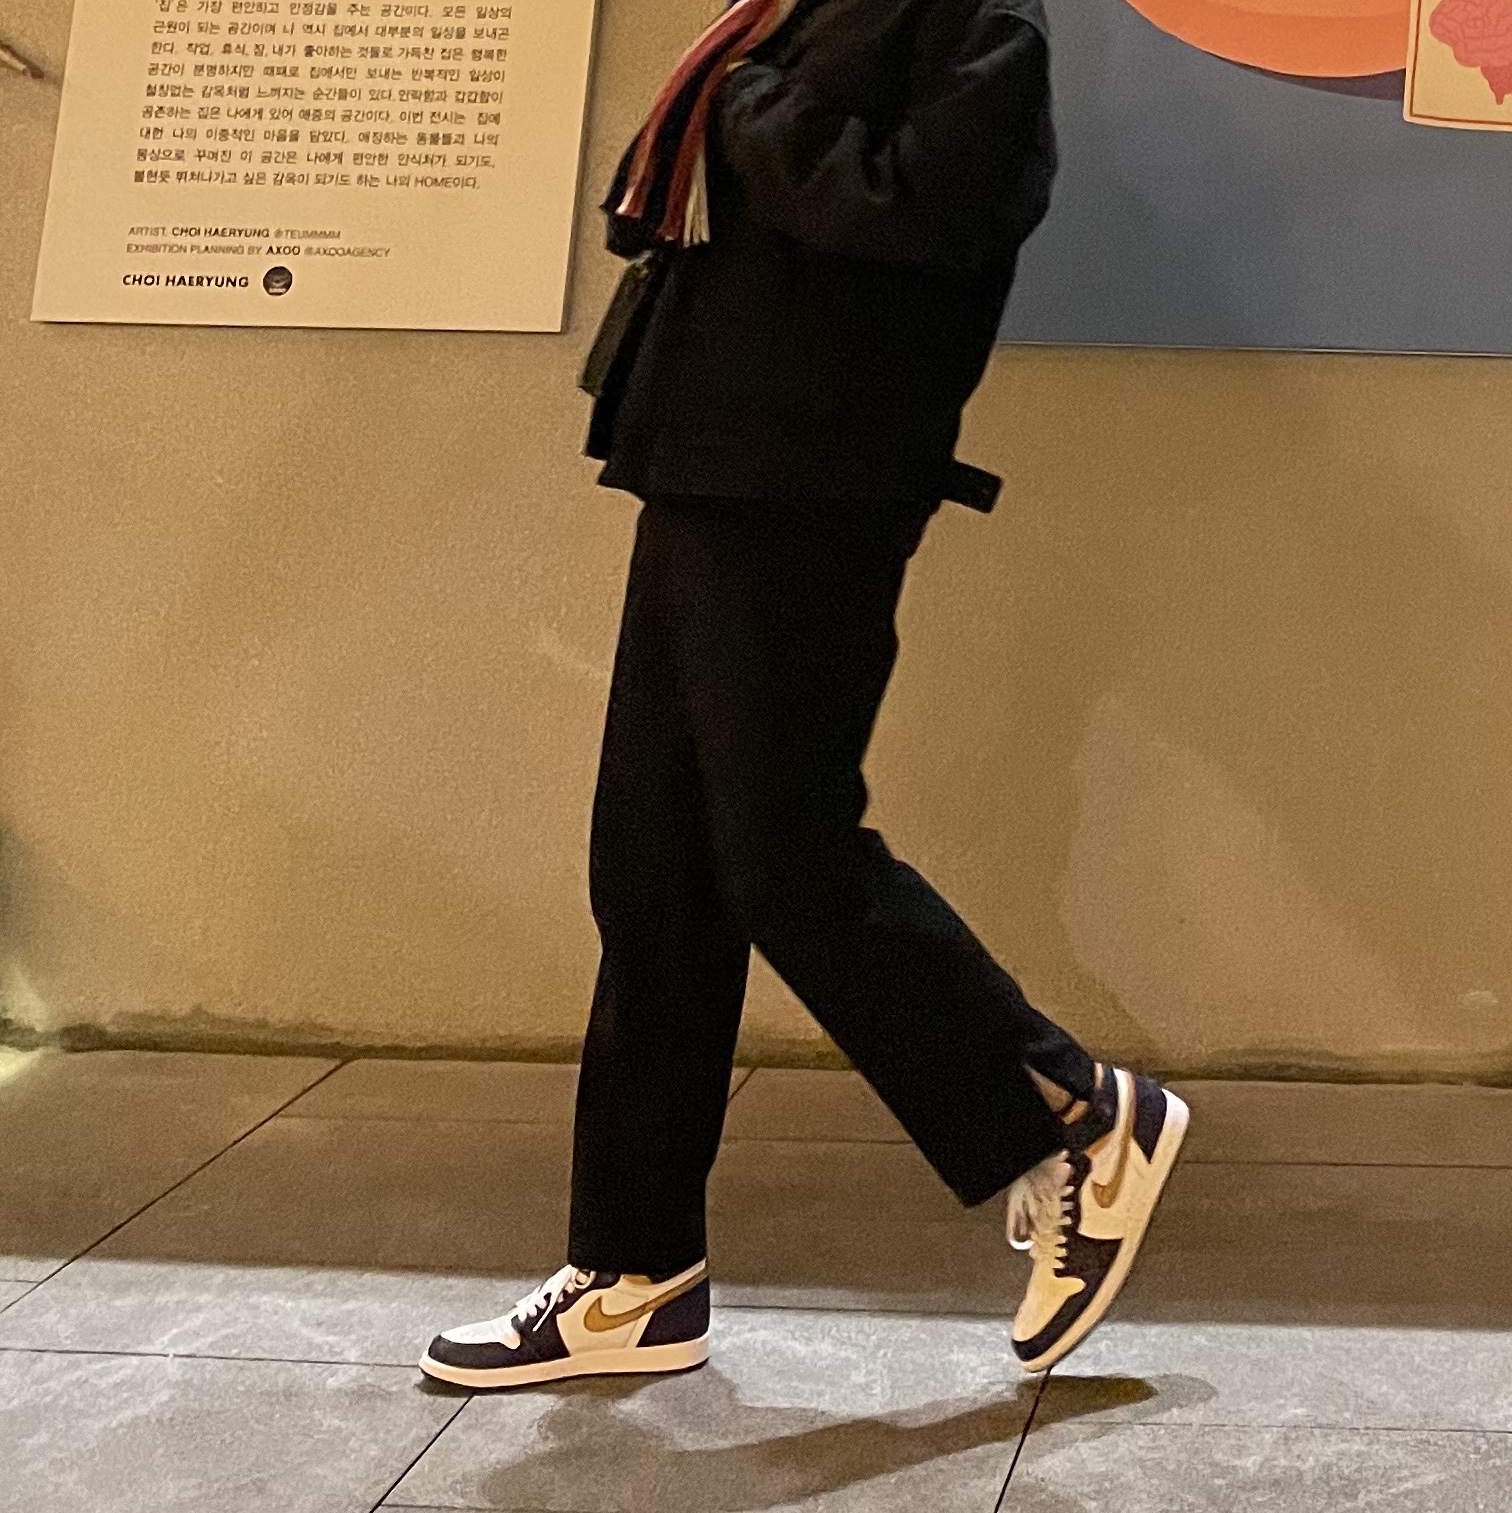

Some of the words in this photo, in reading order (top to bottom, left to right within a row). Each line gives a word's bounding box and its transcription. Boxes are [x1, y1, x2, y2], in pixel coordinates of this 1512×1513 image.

[197, 0, 222, 14] 가장
[232, 0, 279, 14] 편안하고
[289, 1, 337, 16] 안정감을
[347, 2, 371, 17] 주는
[381, 4, 432, 18] 공간이다.
[442, 5, 466, 19] 모든
[476, 5, 512, 20] 일상의
[153, 20, 190, 34] 근원이
[197, 21, 220, 35] 되는
[228, 21, 276, 36] 공간이며
[302, 23, 326, 36] 역시
[333, 24, 369, 38] 집에서
[375, 25, 424, 39] 대부분의
[431, 26, 466, 39] 일상을
[473, 26, 510, 41] 보내곤
[272, 43, 296, 57] 내가
[304, 44, 352, 59] 좋아하는
[357, 45, 393, 60] 것들로
[441, 47, 464, 61] 집은
[471, 47, 507, 62] 행복한
[147, 62, 184, 76] 공간이
[193, 63, 254, 78] 분명하지만
[263, 65, 299, 78] 때때로
[310, 66, 357, 80] 집에서만
[365, 67, 402, 80] 보내는
[411, 67, 460, 82] 반복적인
[469, 68, 505, 83] 일상이
[201, 84, 250, 99] 감옥처럼
[256, 85, 305, 100] 느껴지는
[312, 87, 362, 101] 순간들이
[398, 89, 448, 103] 안락함과
[142, 104, 191, 119] 공존하는
[197, 106, 221, 120] 집은
[226, 106, 264, 120] 나에게
[269, 107, 293, 121] 있어
[298, 108, 336, 122] 애증의
[341, 109, 392, 123] 공간이다.
[400, 110, 424, 124] 이번
[430, 111, 466, 125] 전시는
[477, 112, 501, 125] 집에
[139, 126, 164, 140] 대한
[172, 127, 197, 141] 나의
[206, 127, 255, 142] 이중적인
[263, 128, 300, 143] 마음을
[358, 130, 408, 145] 애정하는
[416, 131, 465, 146] 동물들과
[474, 133, 500, 147] 나의
[196, 148, 231, 163] 꾸며진
[240, 150, 252, 163] 이
[261, 150, 297, 164] 공간은
[306, 151, 343, 165] 나에게
[353, 152, 389, 166] 편안한
[397, 153, 447, 167] 안식처가
[134, 169, 170, 184] 불현듯
[176, 170, 237, 185] 뛰쳐나가고
[243, 171, 267, 185] 싶은
[272, 172, 309, 186] 감옥이
[314, 173, 350, 186] 되기도
[357, 173, 381, 188] 하는
[386, 174, 411, 188] 나의
[172, 227, 201, 238] CHOI
[204, 227, 269, 238] HAERYUNG
[126, 243, 187, 254] EXHIBITION
[190, 244, 245, 255] PLANNING
[247, 245, 262, 255] BY
[265, 245, 301, 256] AXOO
[122, 274, 160, 287] CHOI
[165, 275, 249, 288] HAERYUNG
